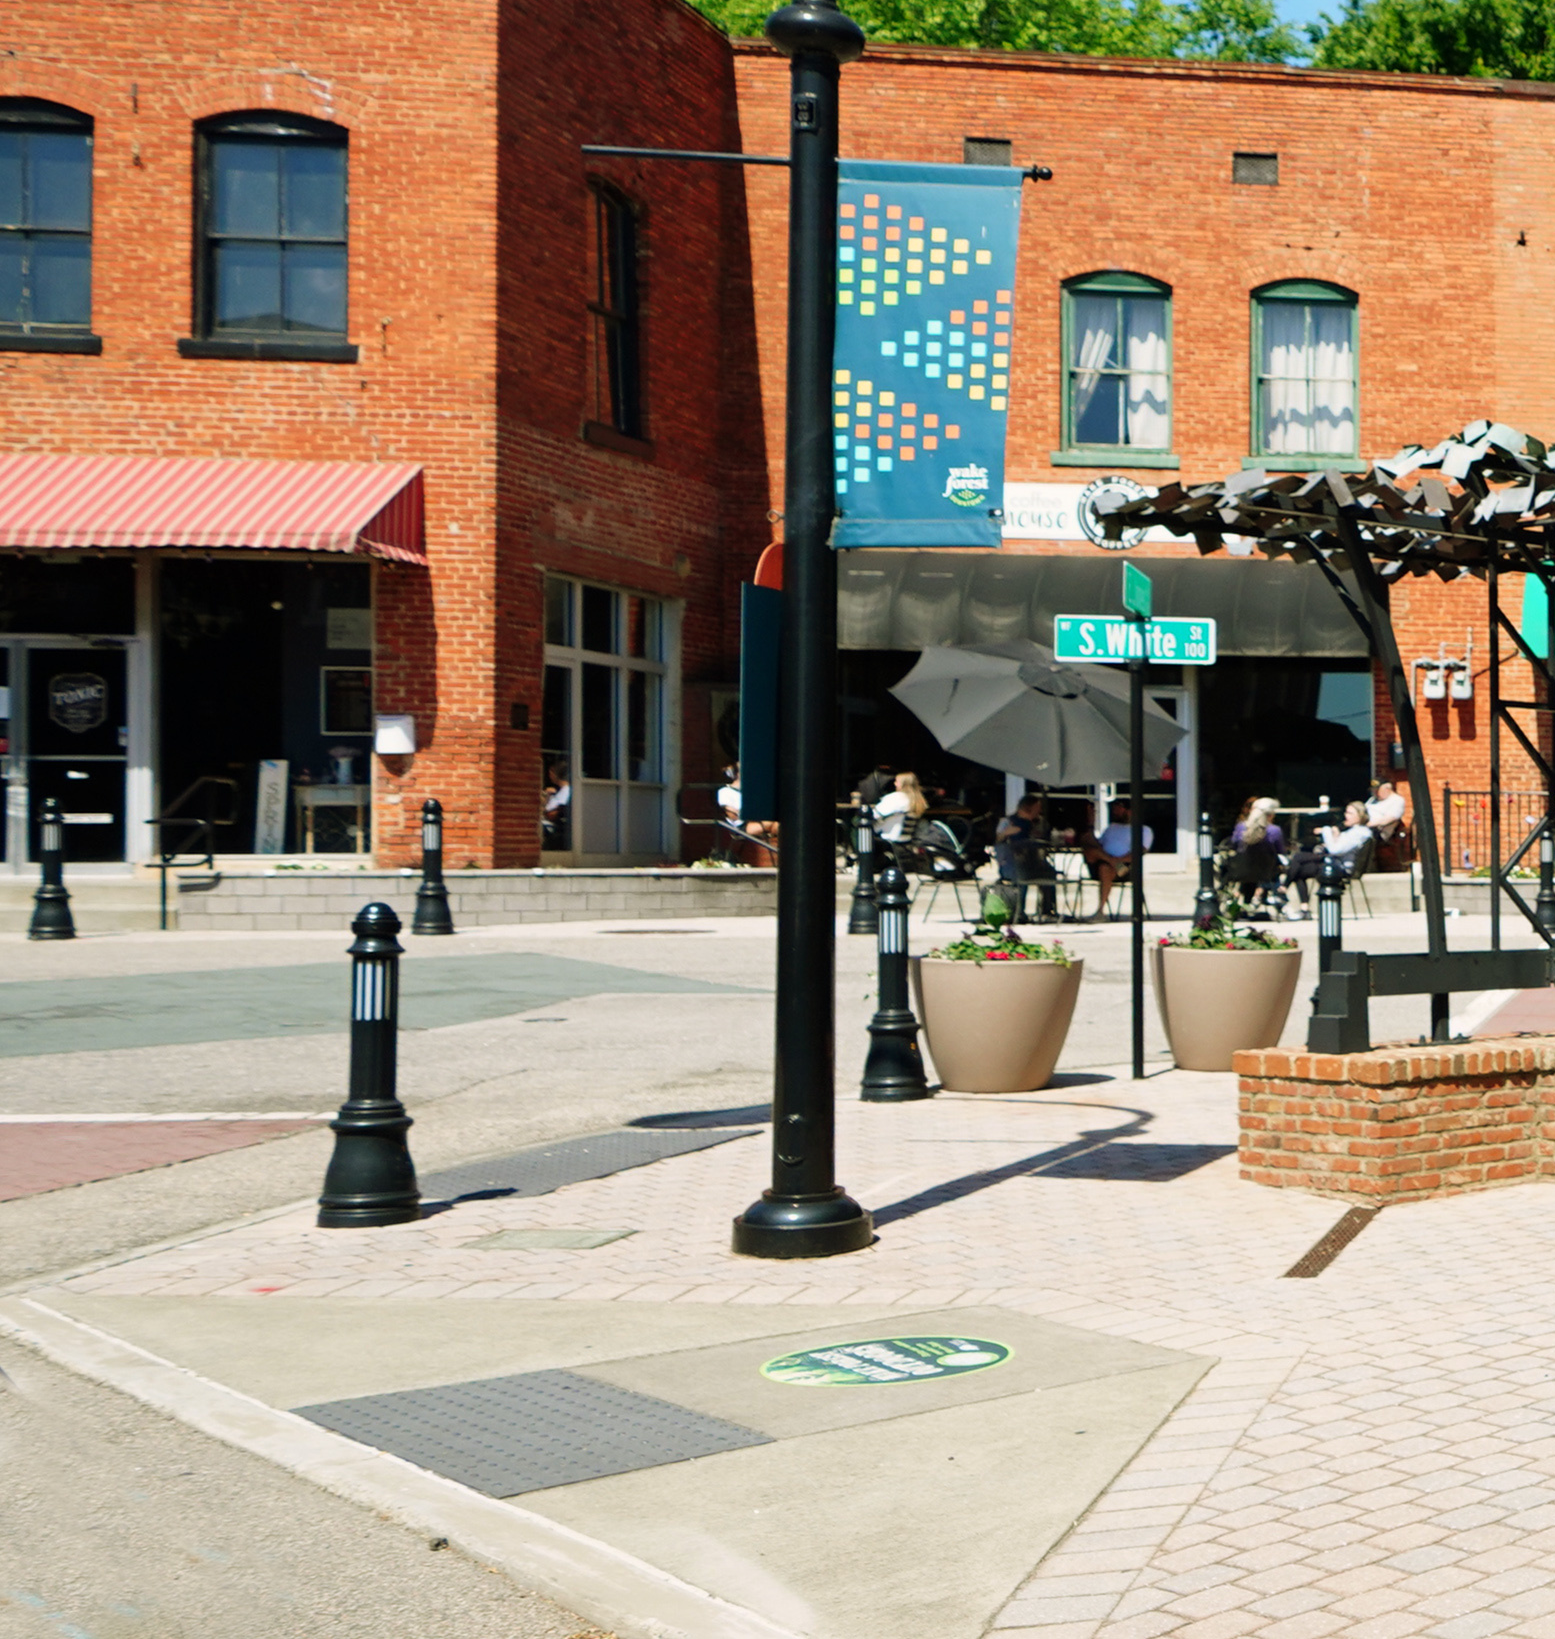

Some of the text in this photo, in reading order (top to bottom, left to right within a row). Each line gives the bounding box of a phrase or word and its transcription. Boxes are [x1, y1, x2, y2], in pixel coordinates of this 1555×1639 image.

[948, 463, 989, 478] wake
[942, 475, 989, 498] forest
[1009, 491, 1063, 508] coffee
[1184, 642, 1207, 658] 100
